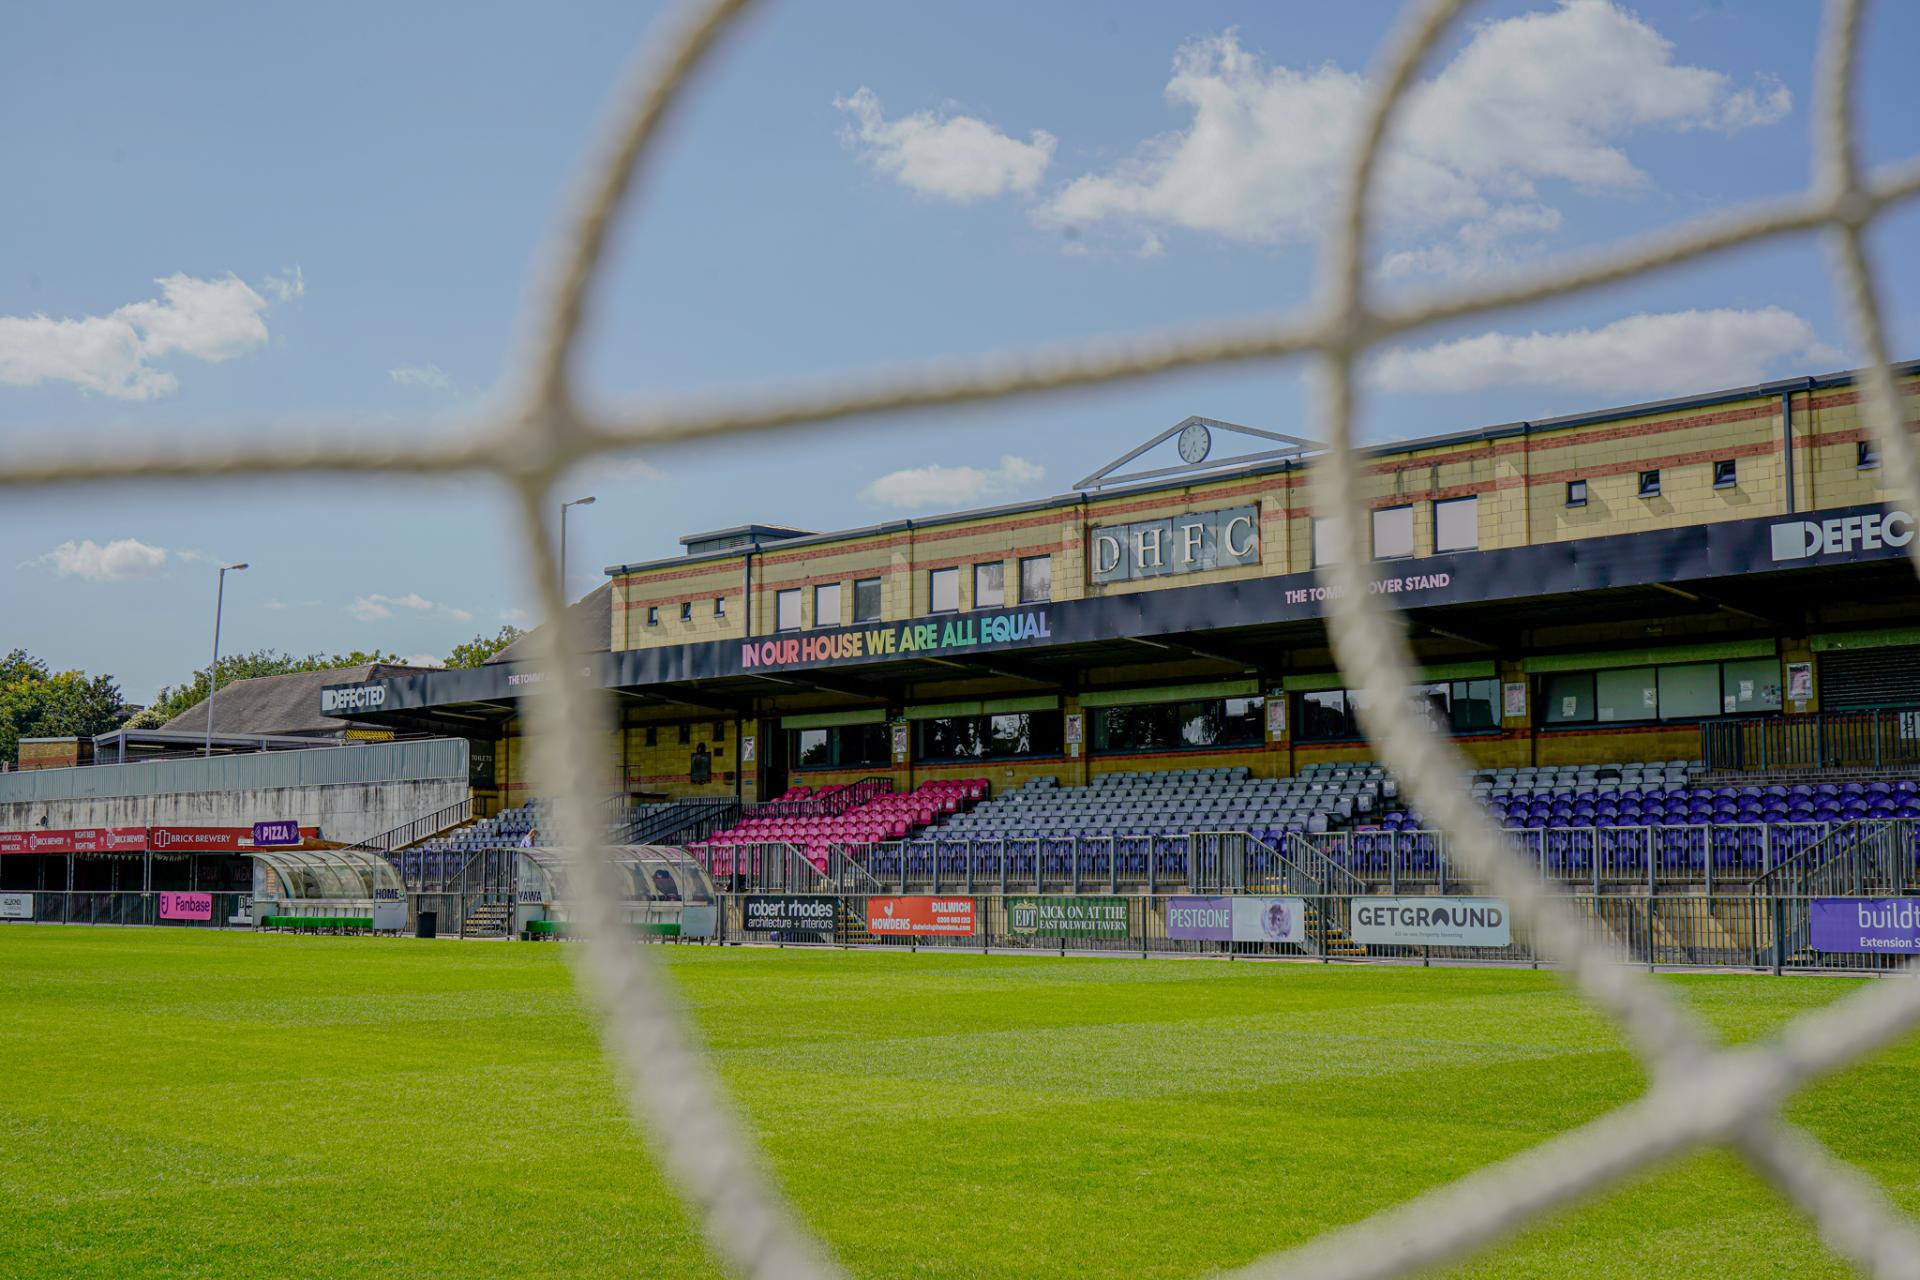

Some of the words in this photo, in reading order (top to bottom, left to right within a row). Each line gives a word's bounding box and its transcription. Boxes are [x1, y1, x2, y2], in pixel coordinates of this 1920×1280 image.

[1771, 511, 1920, 561] DEFEC
[1285, 589, 1307, 604] THE
[1309, 585, 1345, 601] TOMM
[1367, 579, 1402, 595] OVER
[1405, 573, 1450, 592] STAND
[742, 643, 759, 668] IN
[761, 639, 798, 667] OUR
[801, 631, 862, 664] HOUSE
[865, 629, 896, 656] WE
[899, 623, 937, 653] ARE
[941, 619, 977, 648] ALL
[980, 611, 1051, 644] EQUAL
[508, 675, 520, 685] THE
[322, 685, 386, 711] DEFECTED
[171, 834, 194, 843] BRICK
[195, 834, 231, 843] BREWERY
[263, 825, 289, 841] PIZZA
[376, 889, 399, 899] HOME
[175, 896, 210, 912] Fanbase
[748, 899, 786, 917] robert
[788, 899, 833, 917] rhodes
[931, 902, 971, 913] DULWICH
[1015, 909, 1037, 927] EDT
[1040, 905, 1065, 919] KICK
[1067, 906, 1084, 919] ON
[1087, 906, 1102, 919] AT
[1103, 906, 1127, 920] THE
[1170, 908, 1230, 928] PESTGONE
[1358, 907, 1503, 928] GETGROUND
[748, 917, 792, 929] architecture
[801, 917, 833, 929] interiors
[871, 918, 911, 930] HOWDENS
[1040, 920, 1058, 929] EAST
[1060, 920, 1095, 930] DULWICH
[1097, 921, 1127, 930] TAVERN
[1860, 937, 1912, 948] Extension
